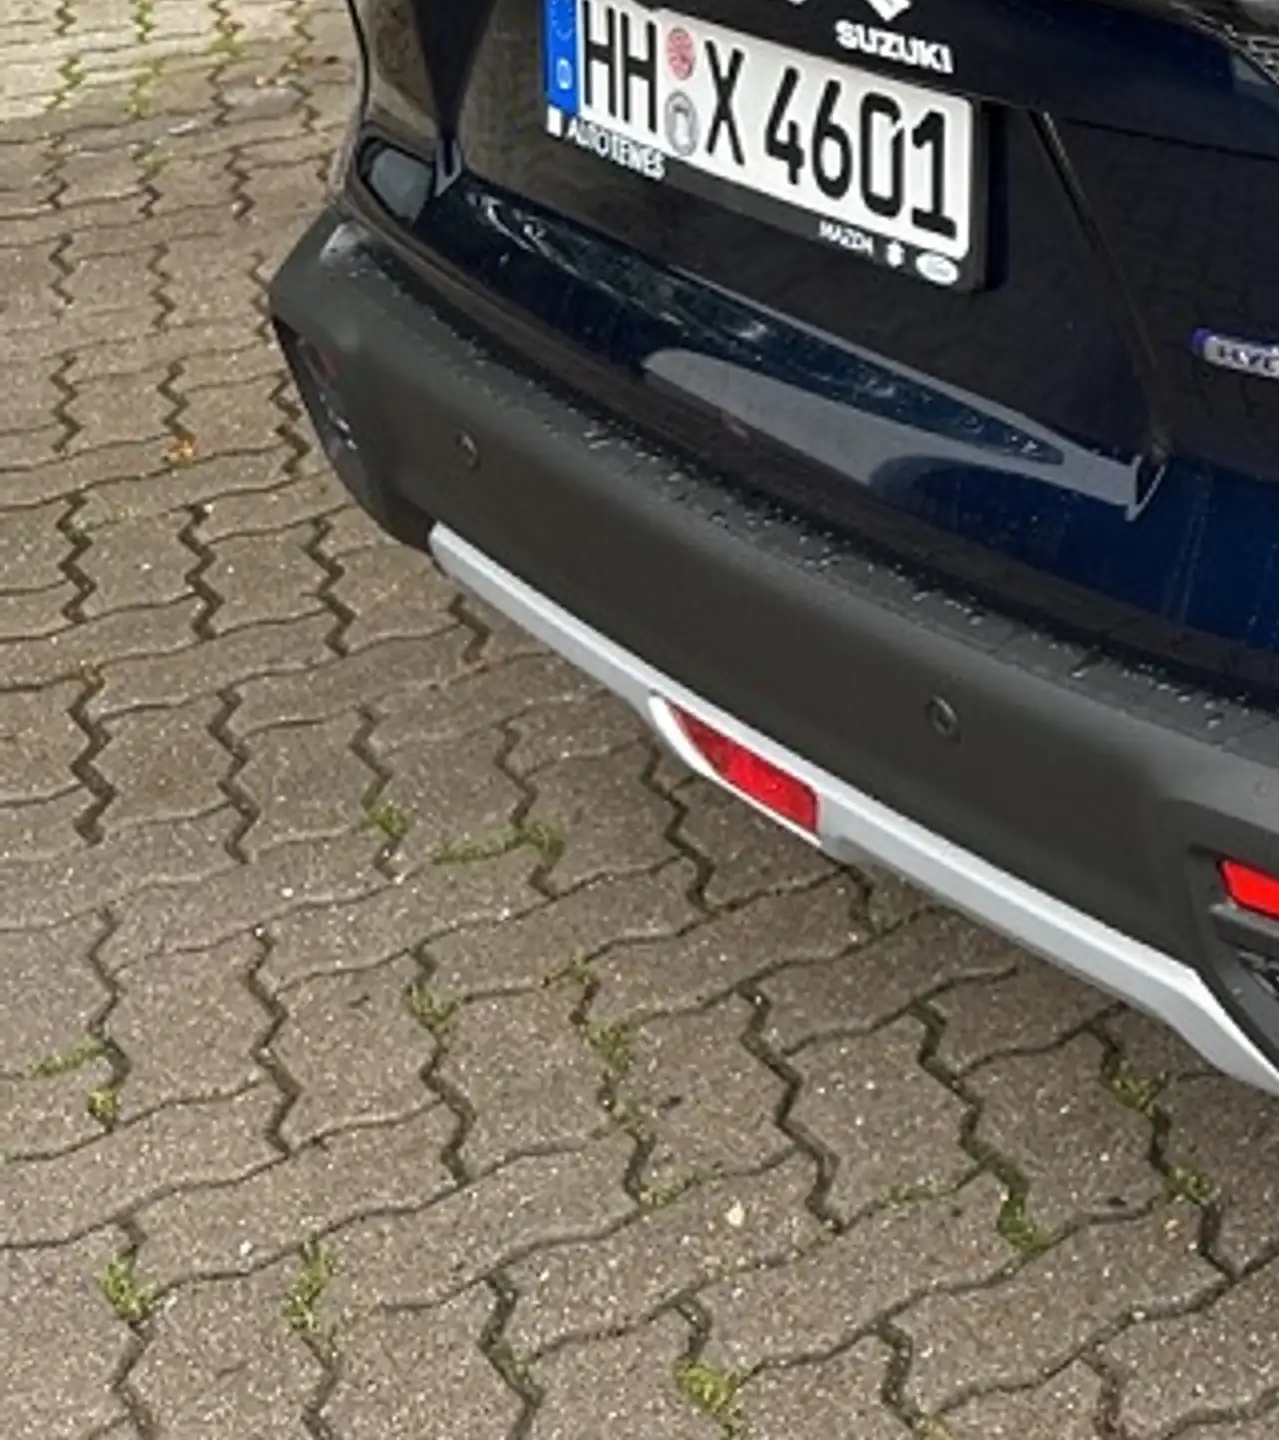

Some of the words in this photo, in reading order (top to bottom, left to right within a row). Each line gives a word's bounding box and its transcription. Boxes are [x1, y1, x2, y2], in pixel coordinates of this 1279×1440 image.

[835, 19, 953, 74] SUZUKI
[704, 40, 746, 166] X
[765, 66, 957, 240] 4601
